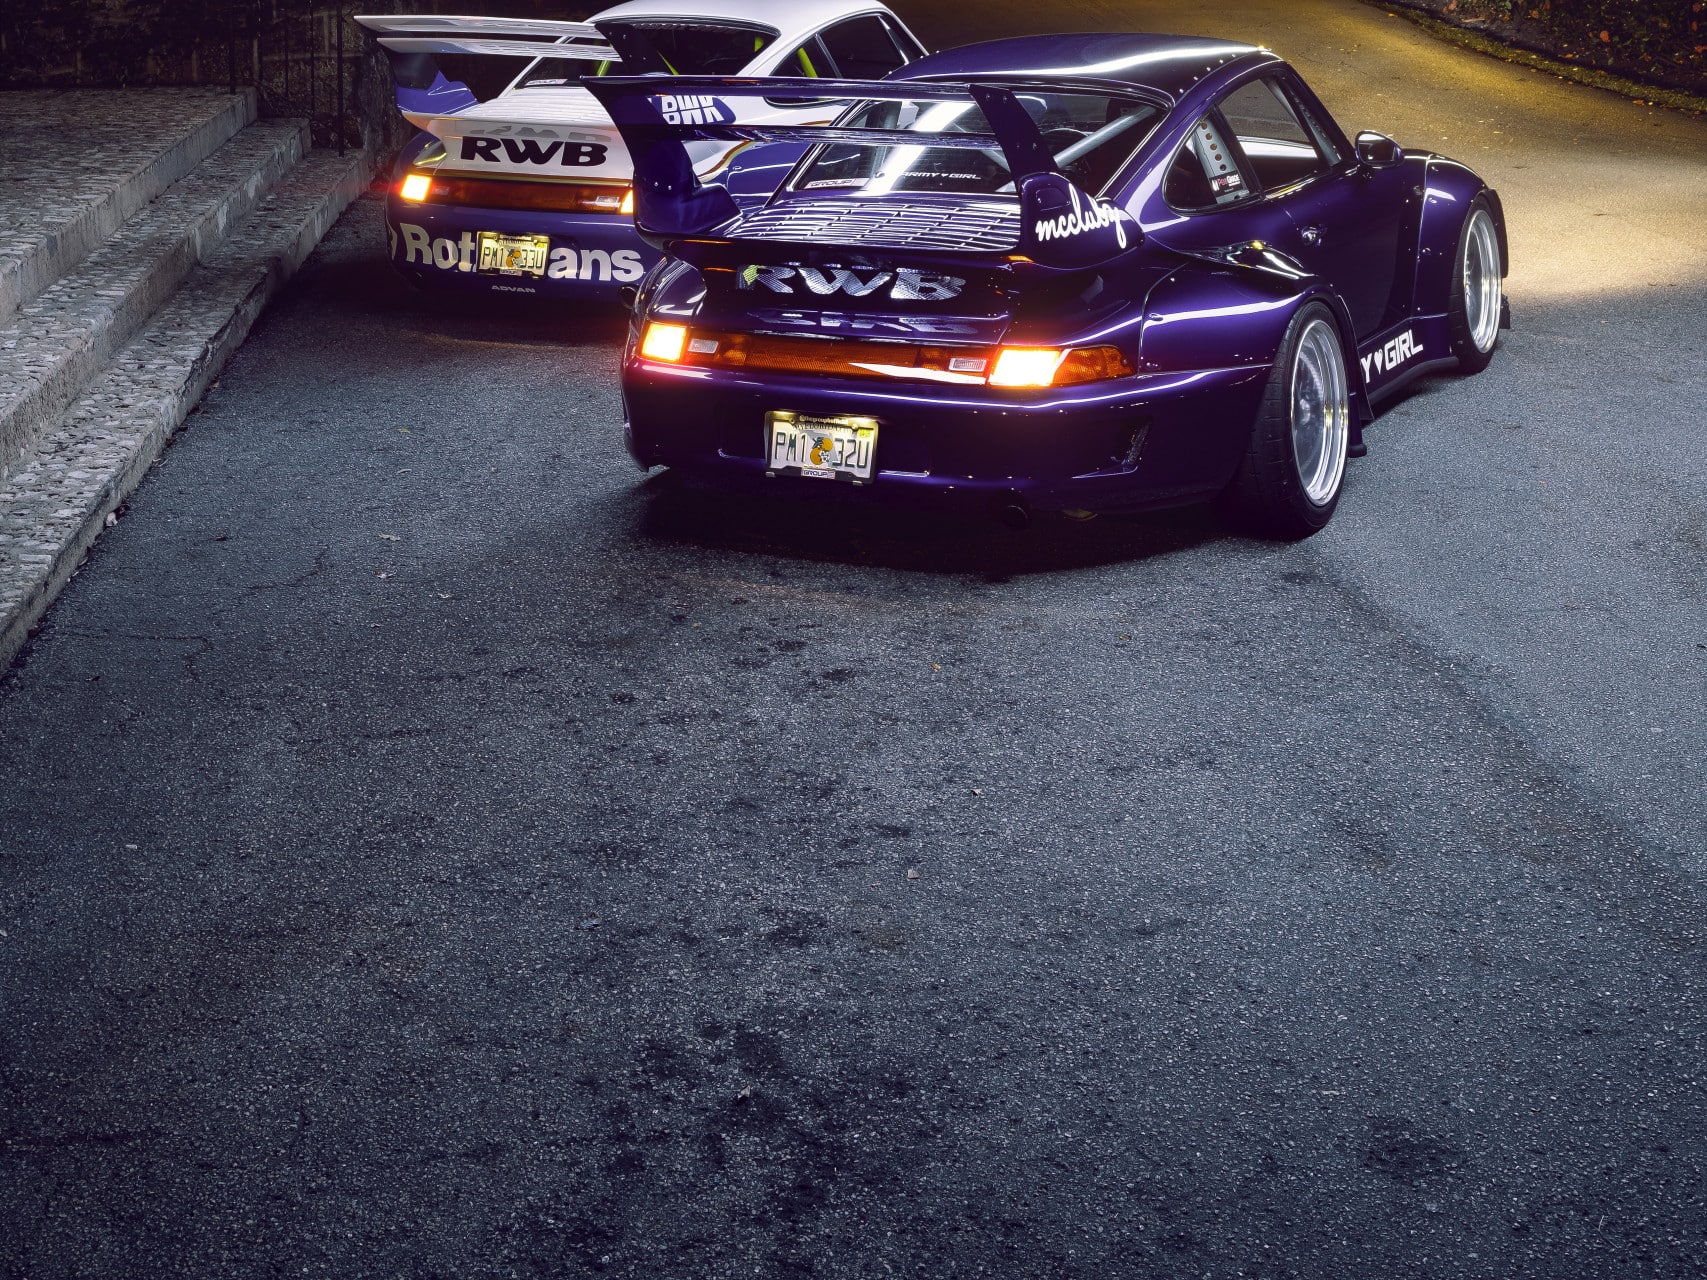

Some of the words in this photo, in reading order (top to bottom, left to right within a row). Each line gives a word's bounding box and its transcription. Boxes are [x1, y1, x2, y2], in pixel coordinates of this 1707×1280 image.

[460, 136, 609, 167] RWB
[948, 172, 982, 180] GIRL
[400, 223, 646, 282] Rotans
[491, 285, 536, 293] ADVAN
[737, 264, 967, 301] RWB
[1384, 329, 1424, 371] GIRL
